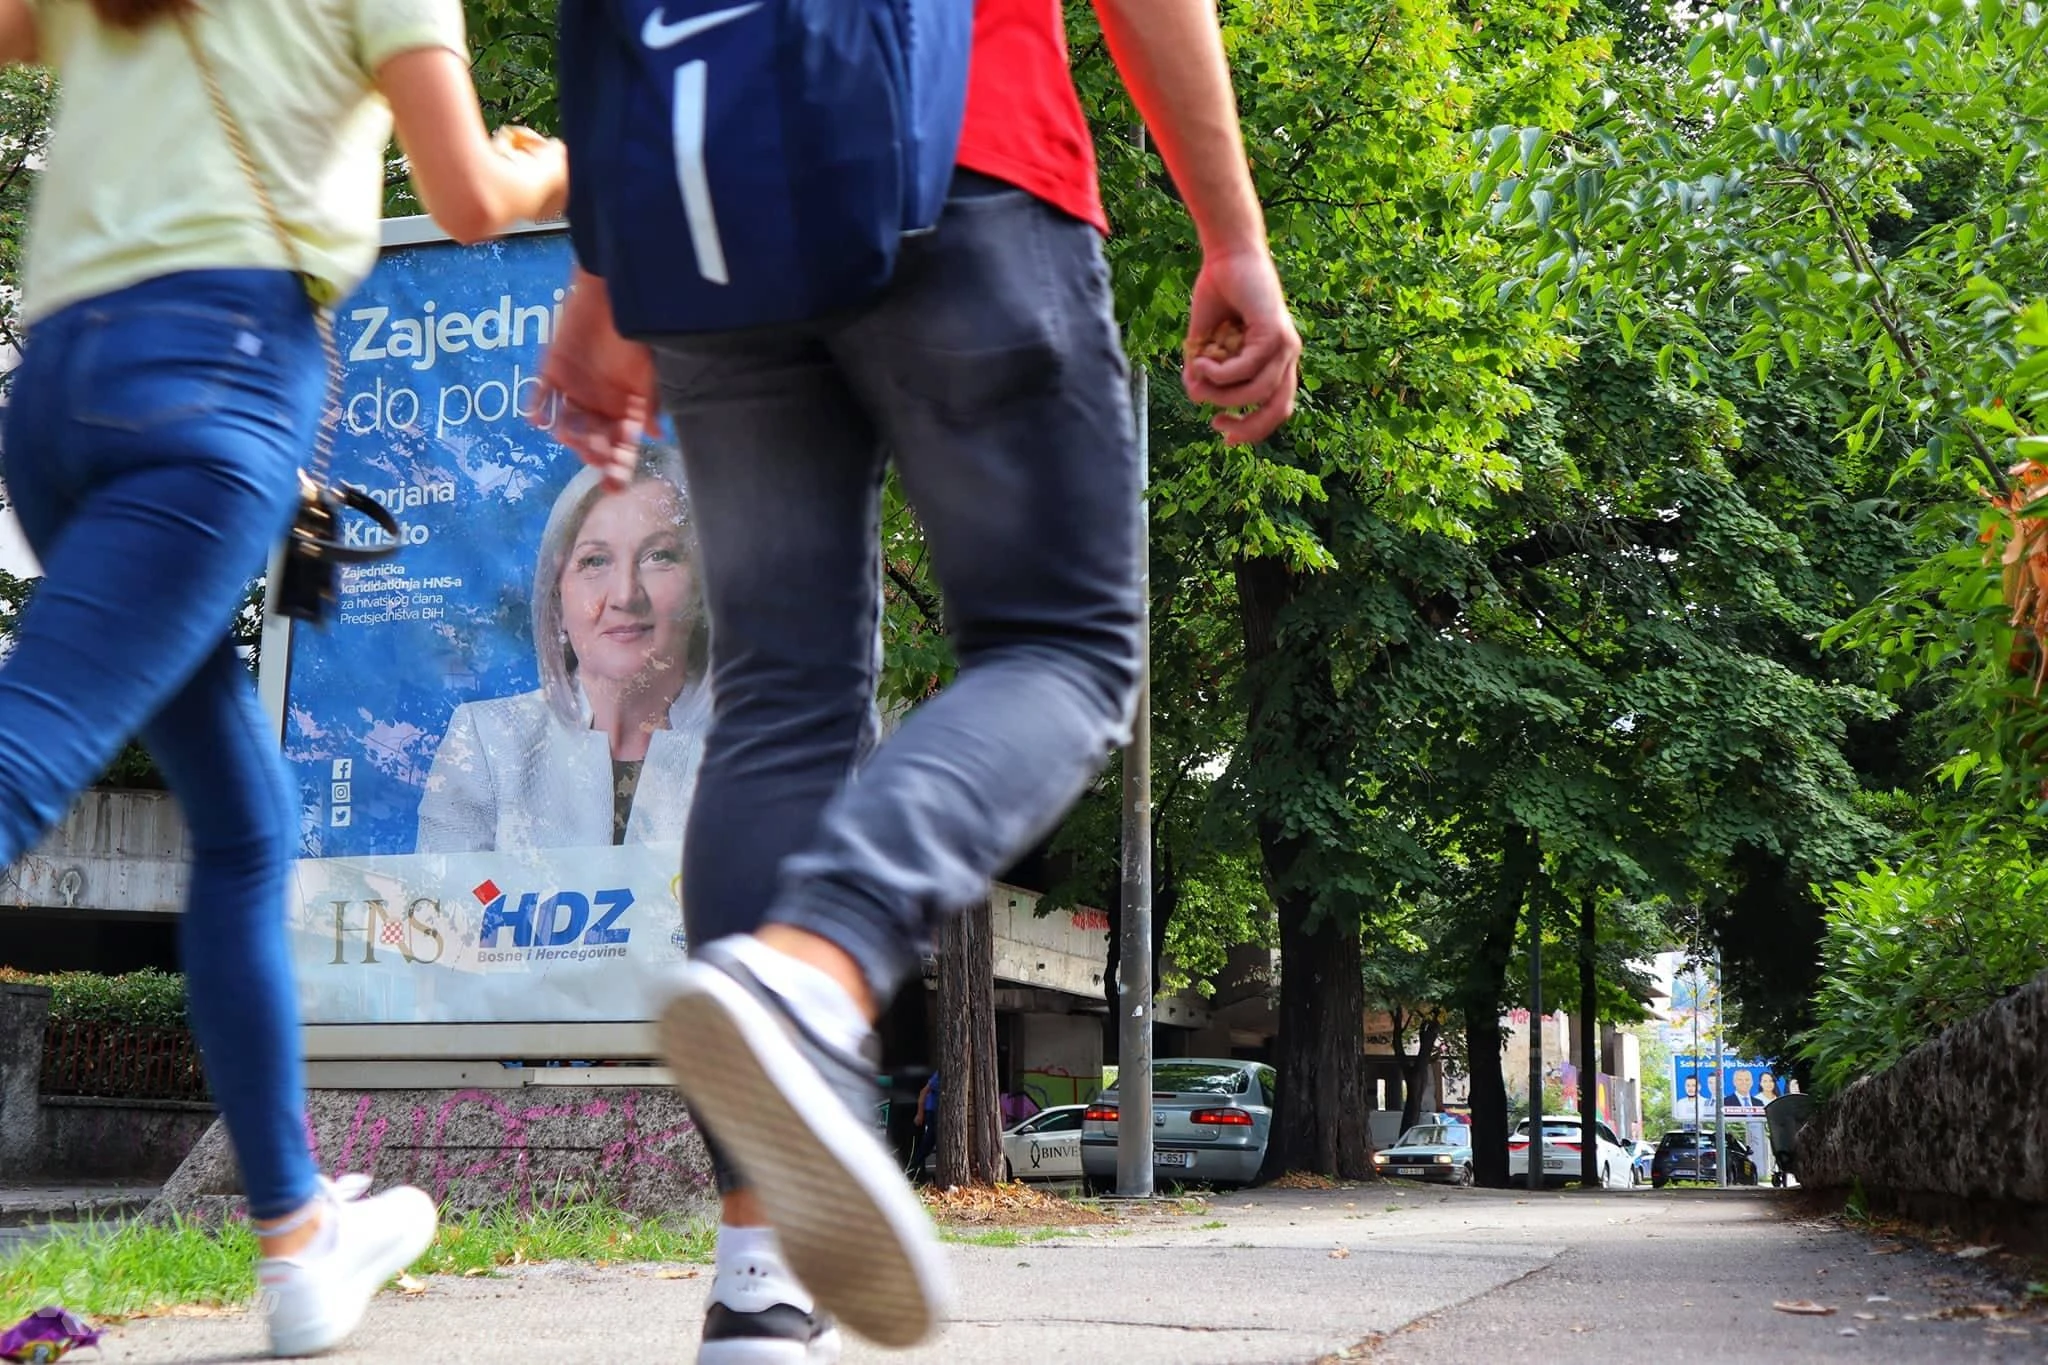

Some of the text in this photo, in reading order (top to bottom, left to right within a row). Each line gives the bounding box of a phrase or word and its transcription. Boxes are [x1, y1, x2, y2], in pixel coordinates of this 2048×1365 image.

[349, 288, 566, 371] Zajedni
[347, 364, 559, 440] do pobj
[341, 564, 405, 580] Zajednička
[341, 576, 462, 595] kandidatkinja HNS-a
[341, 592, 443, 610] za hrvatskog člana
[340, 608, 444, 626] Predsjedništva BiH
[478, 888, 636, 949] HDZ
[477, 946, 628, 963] Bosne i Hercegovine
[1041, 1146, 1080, 1159] BINVE
[1153, 1152, 1184, 1164] -T-851
